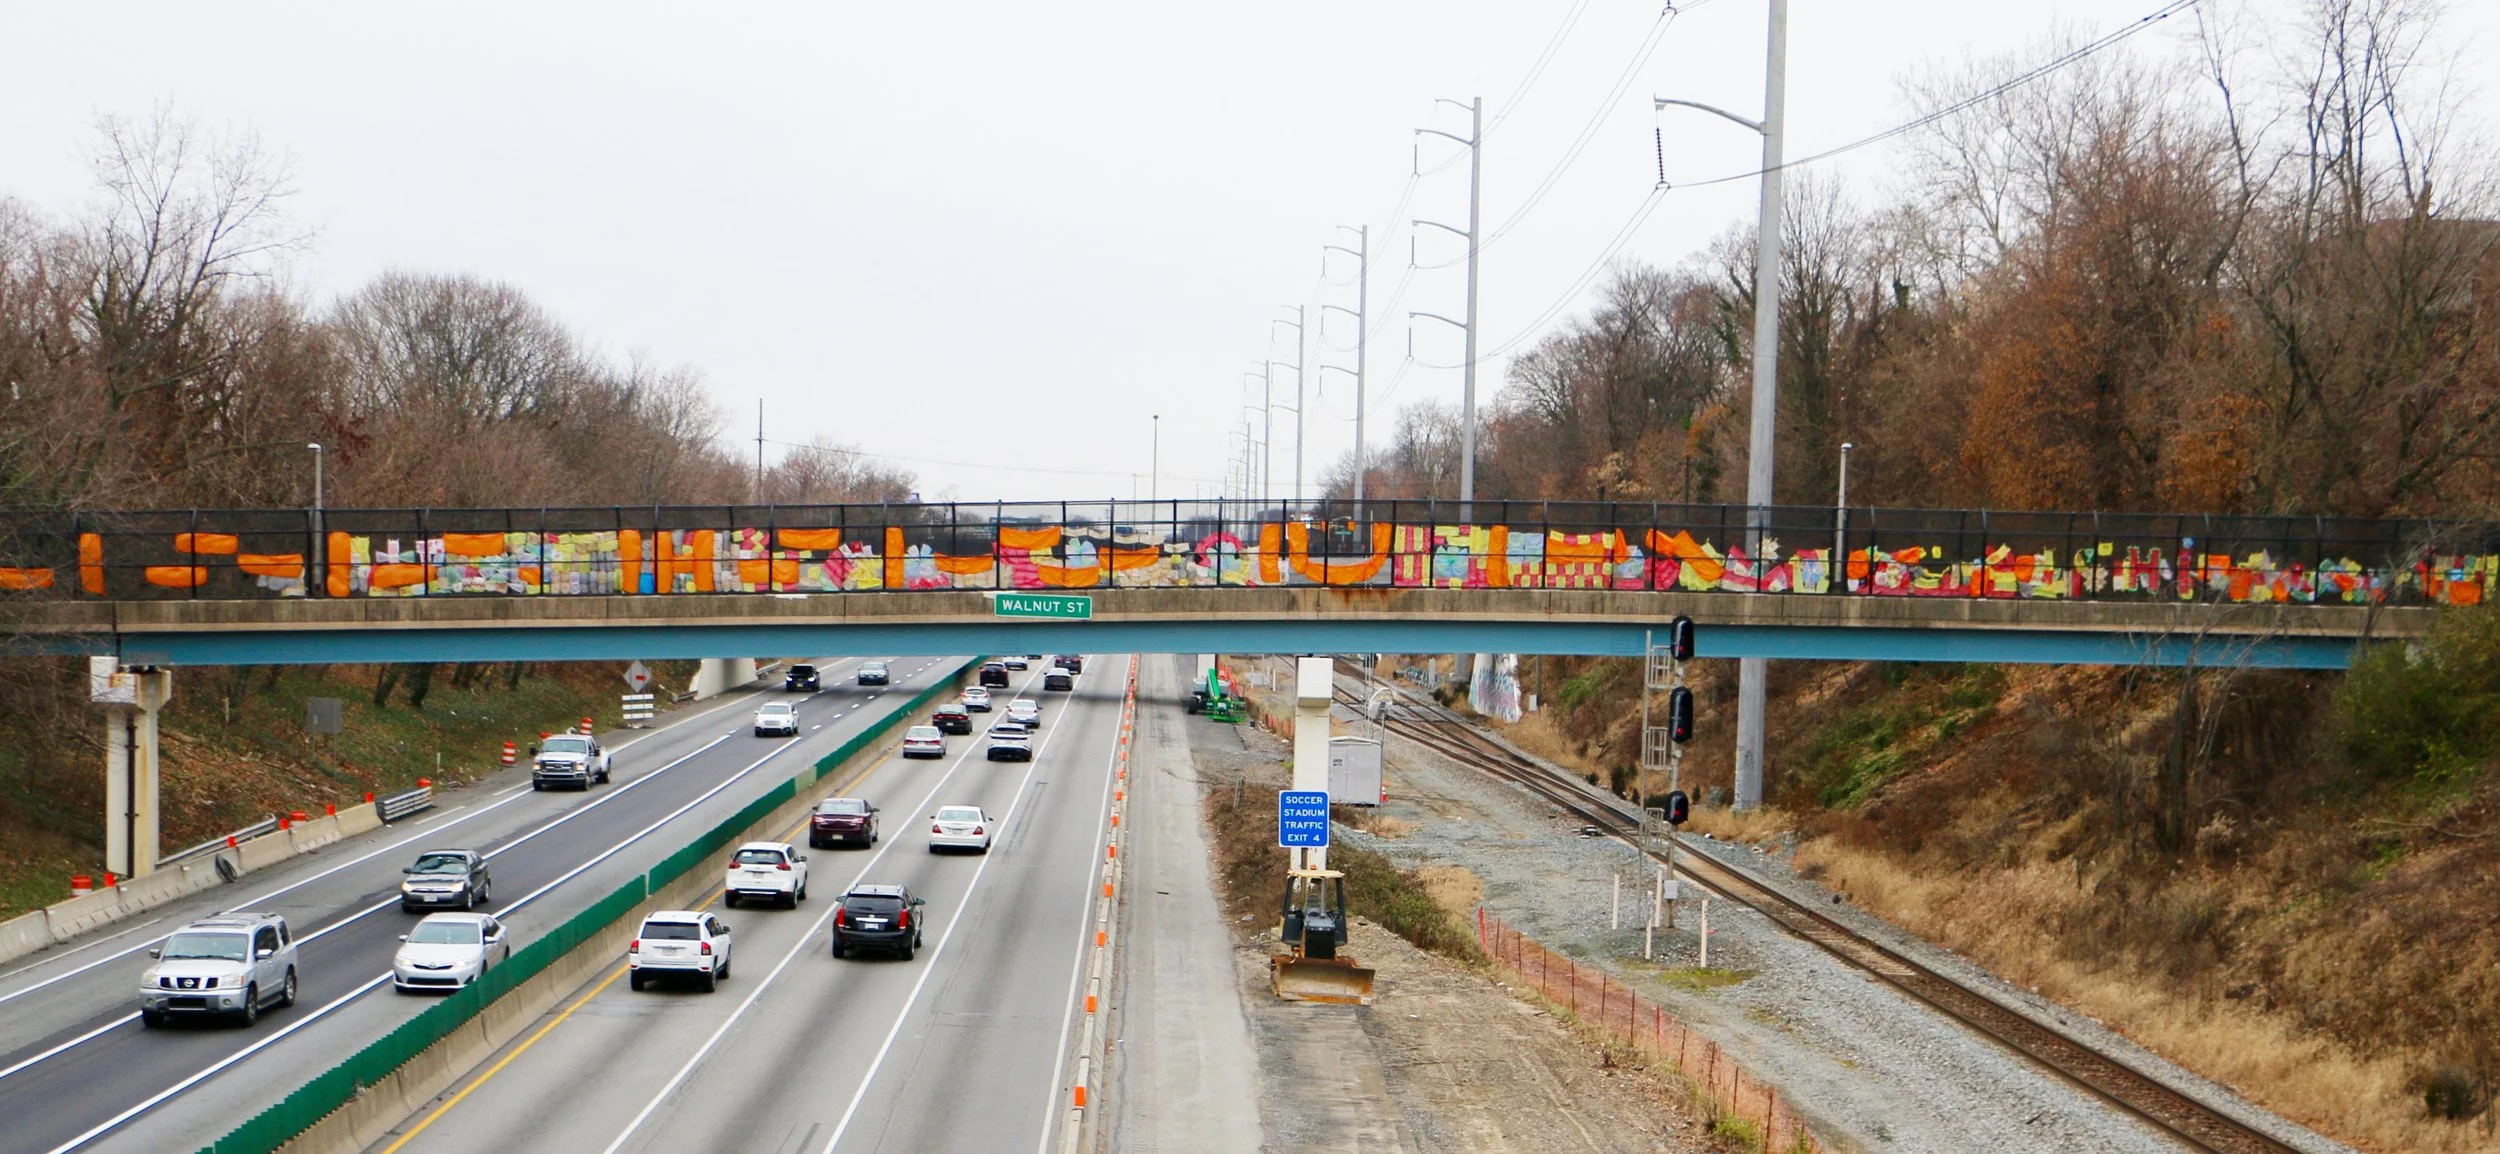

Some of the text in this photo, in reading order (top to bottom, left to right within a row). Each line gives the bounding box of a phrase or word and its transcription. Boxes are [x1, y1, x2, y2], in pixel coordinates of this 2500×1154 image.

[1002, 599, 1084, 613] WALNUT ST
[1286, 796, 1323, 804] SOCCER
[1284, 808, 1324, 816] STADIUM
[1284, 821, 1323, 829] TRAFFIC
